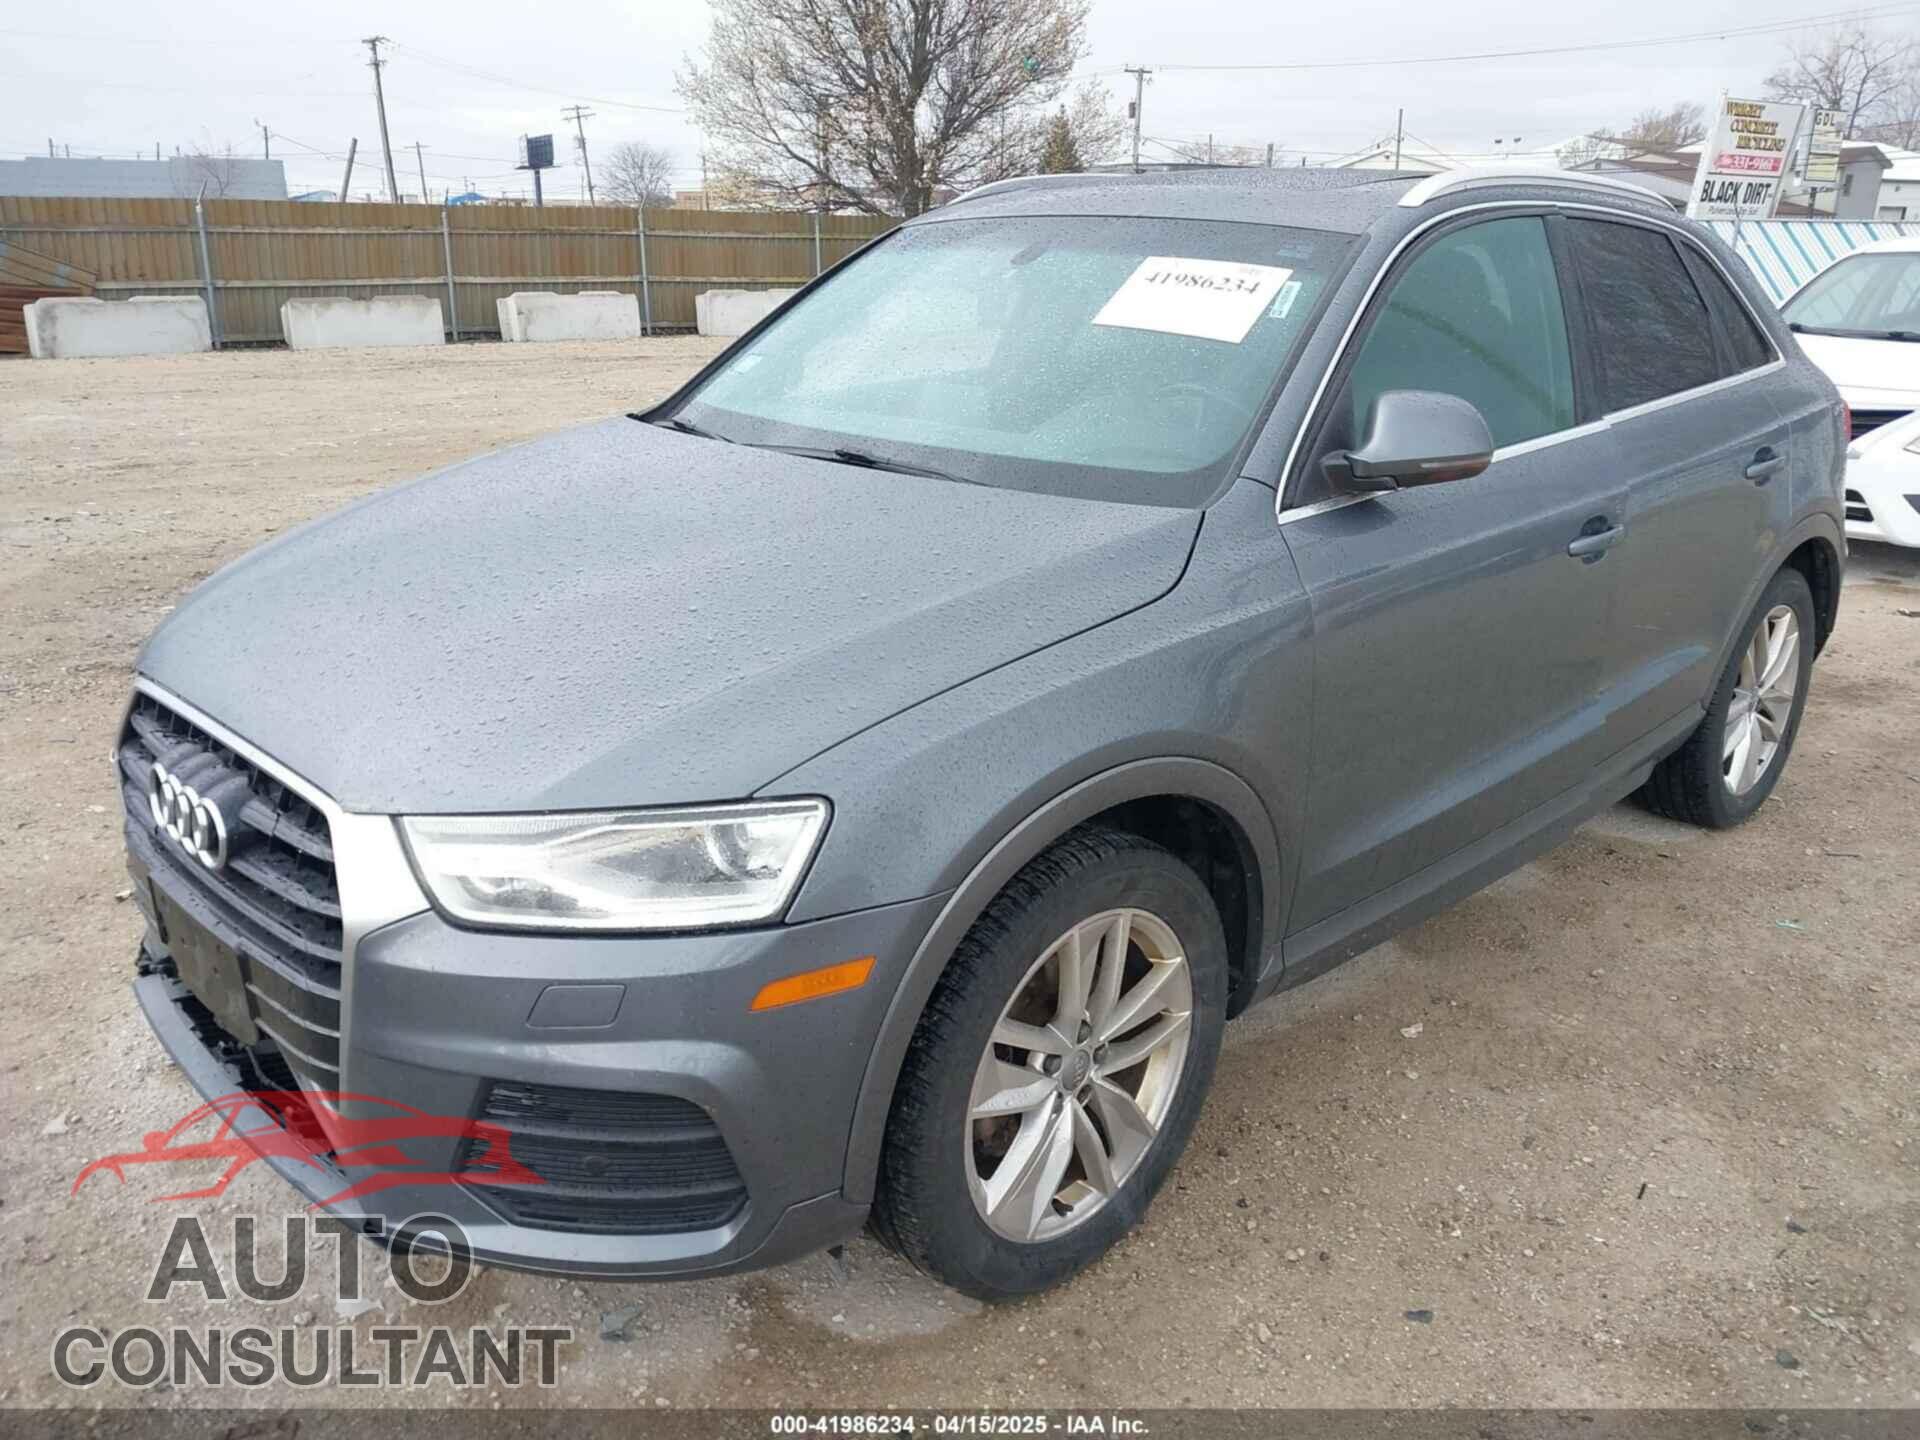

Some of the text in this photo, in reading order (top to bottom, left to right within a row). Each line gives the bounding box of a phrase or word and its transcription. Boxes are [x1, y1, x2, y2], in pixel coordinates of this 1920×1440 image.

[1700, 179, 1772, 205] BLACK DIRT
[1145, 271, 1261, 295] 41986234
